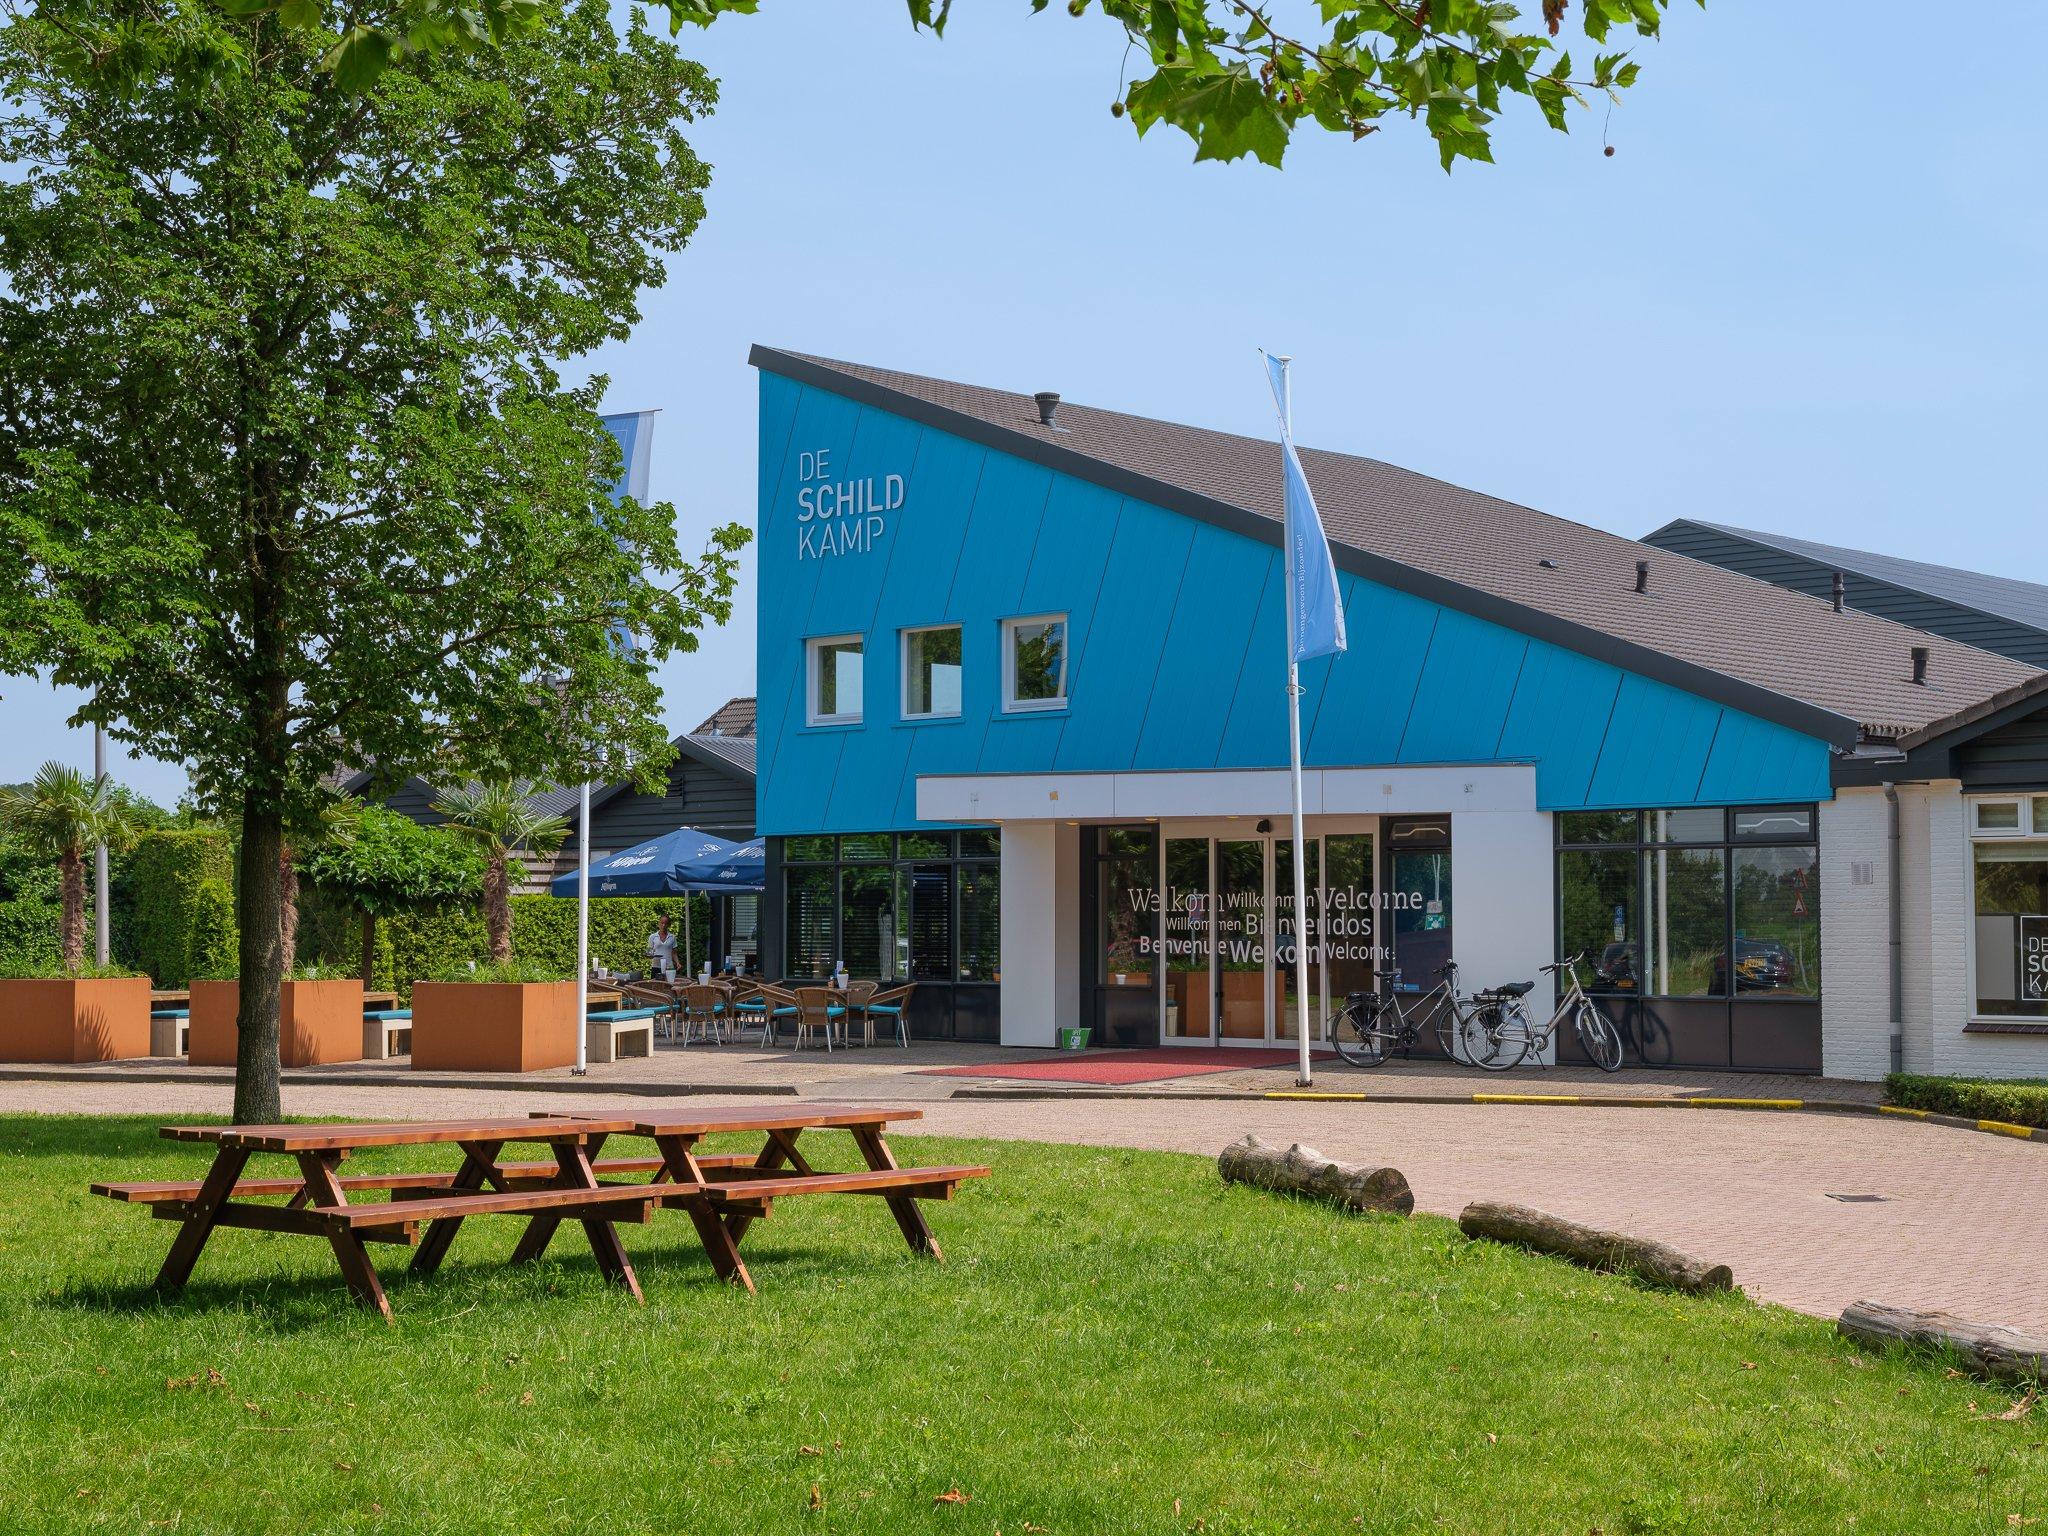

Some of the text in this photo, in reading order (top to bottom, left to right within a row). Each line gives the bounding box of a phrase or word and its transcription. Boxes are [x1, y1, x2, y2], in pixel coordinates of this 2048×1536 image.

[800, 449, 830, 482] DE
[798, 474, 904, 522] SCHILD
[799, 516, 884, 561] KAMP
[1227, 892, 1314, 908] Willkmmn
[1314, 885, 1423, 910] Welcome
[1246, 912, 1372, 936] Binveidos
[1229, 939, 1320, 964] Wekom
